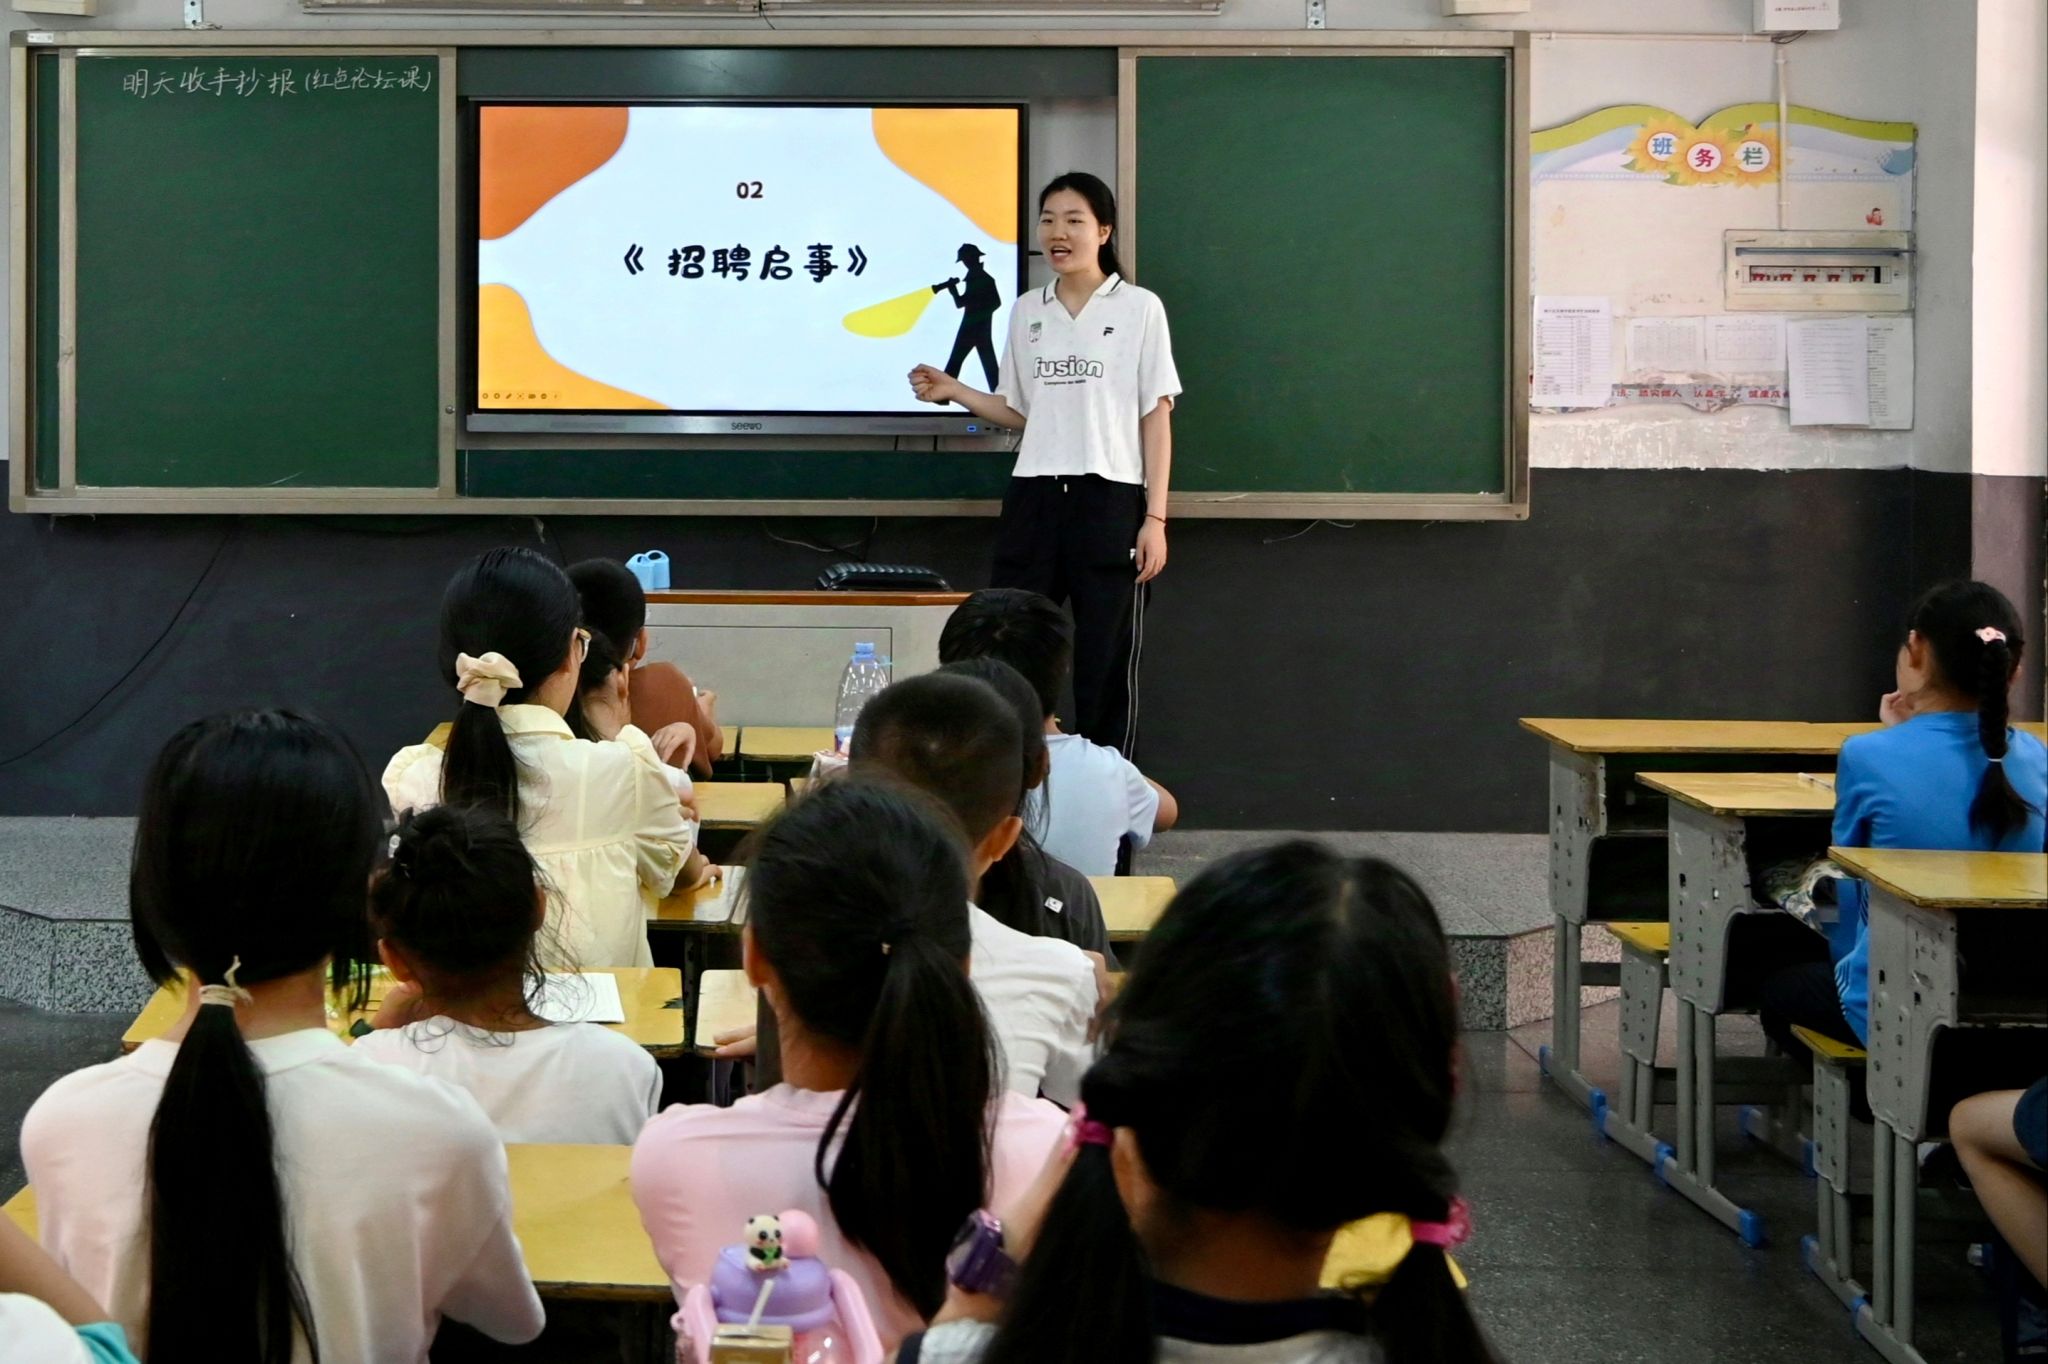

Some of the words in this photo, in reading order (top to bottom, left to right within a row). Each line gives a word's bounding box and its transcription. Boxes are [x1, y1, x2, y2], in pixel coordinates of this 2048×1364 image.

[1652, 137, 1764, 168] 班务栏
[736, 181, 764, 199] 02
[624, 242, 868, 283] 《招聘启事》
[1033, 355, 1104, 378] fusion
[731, 422, 763, 431] seewo
